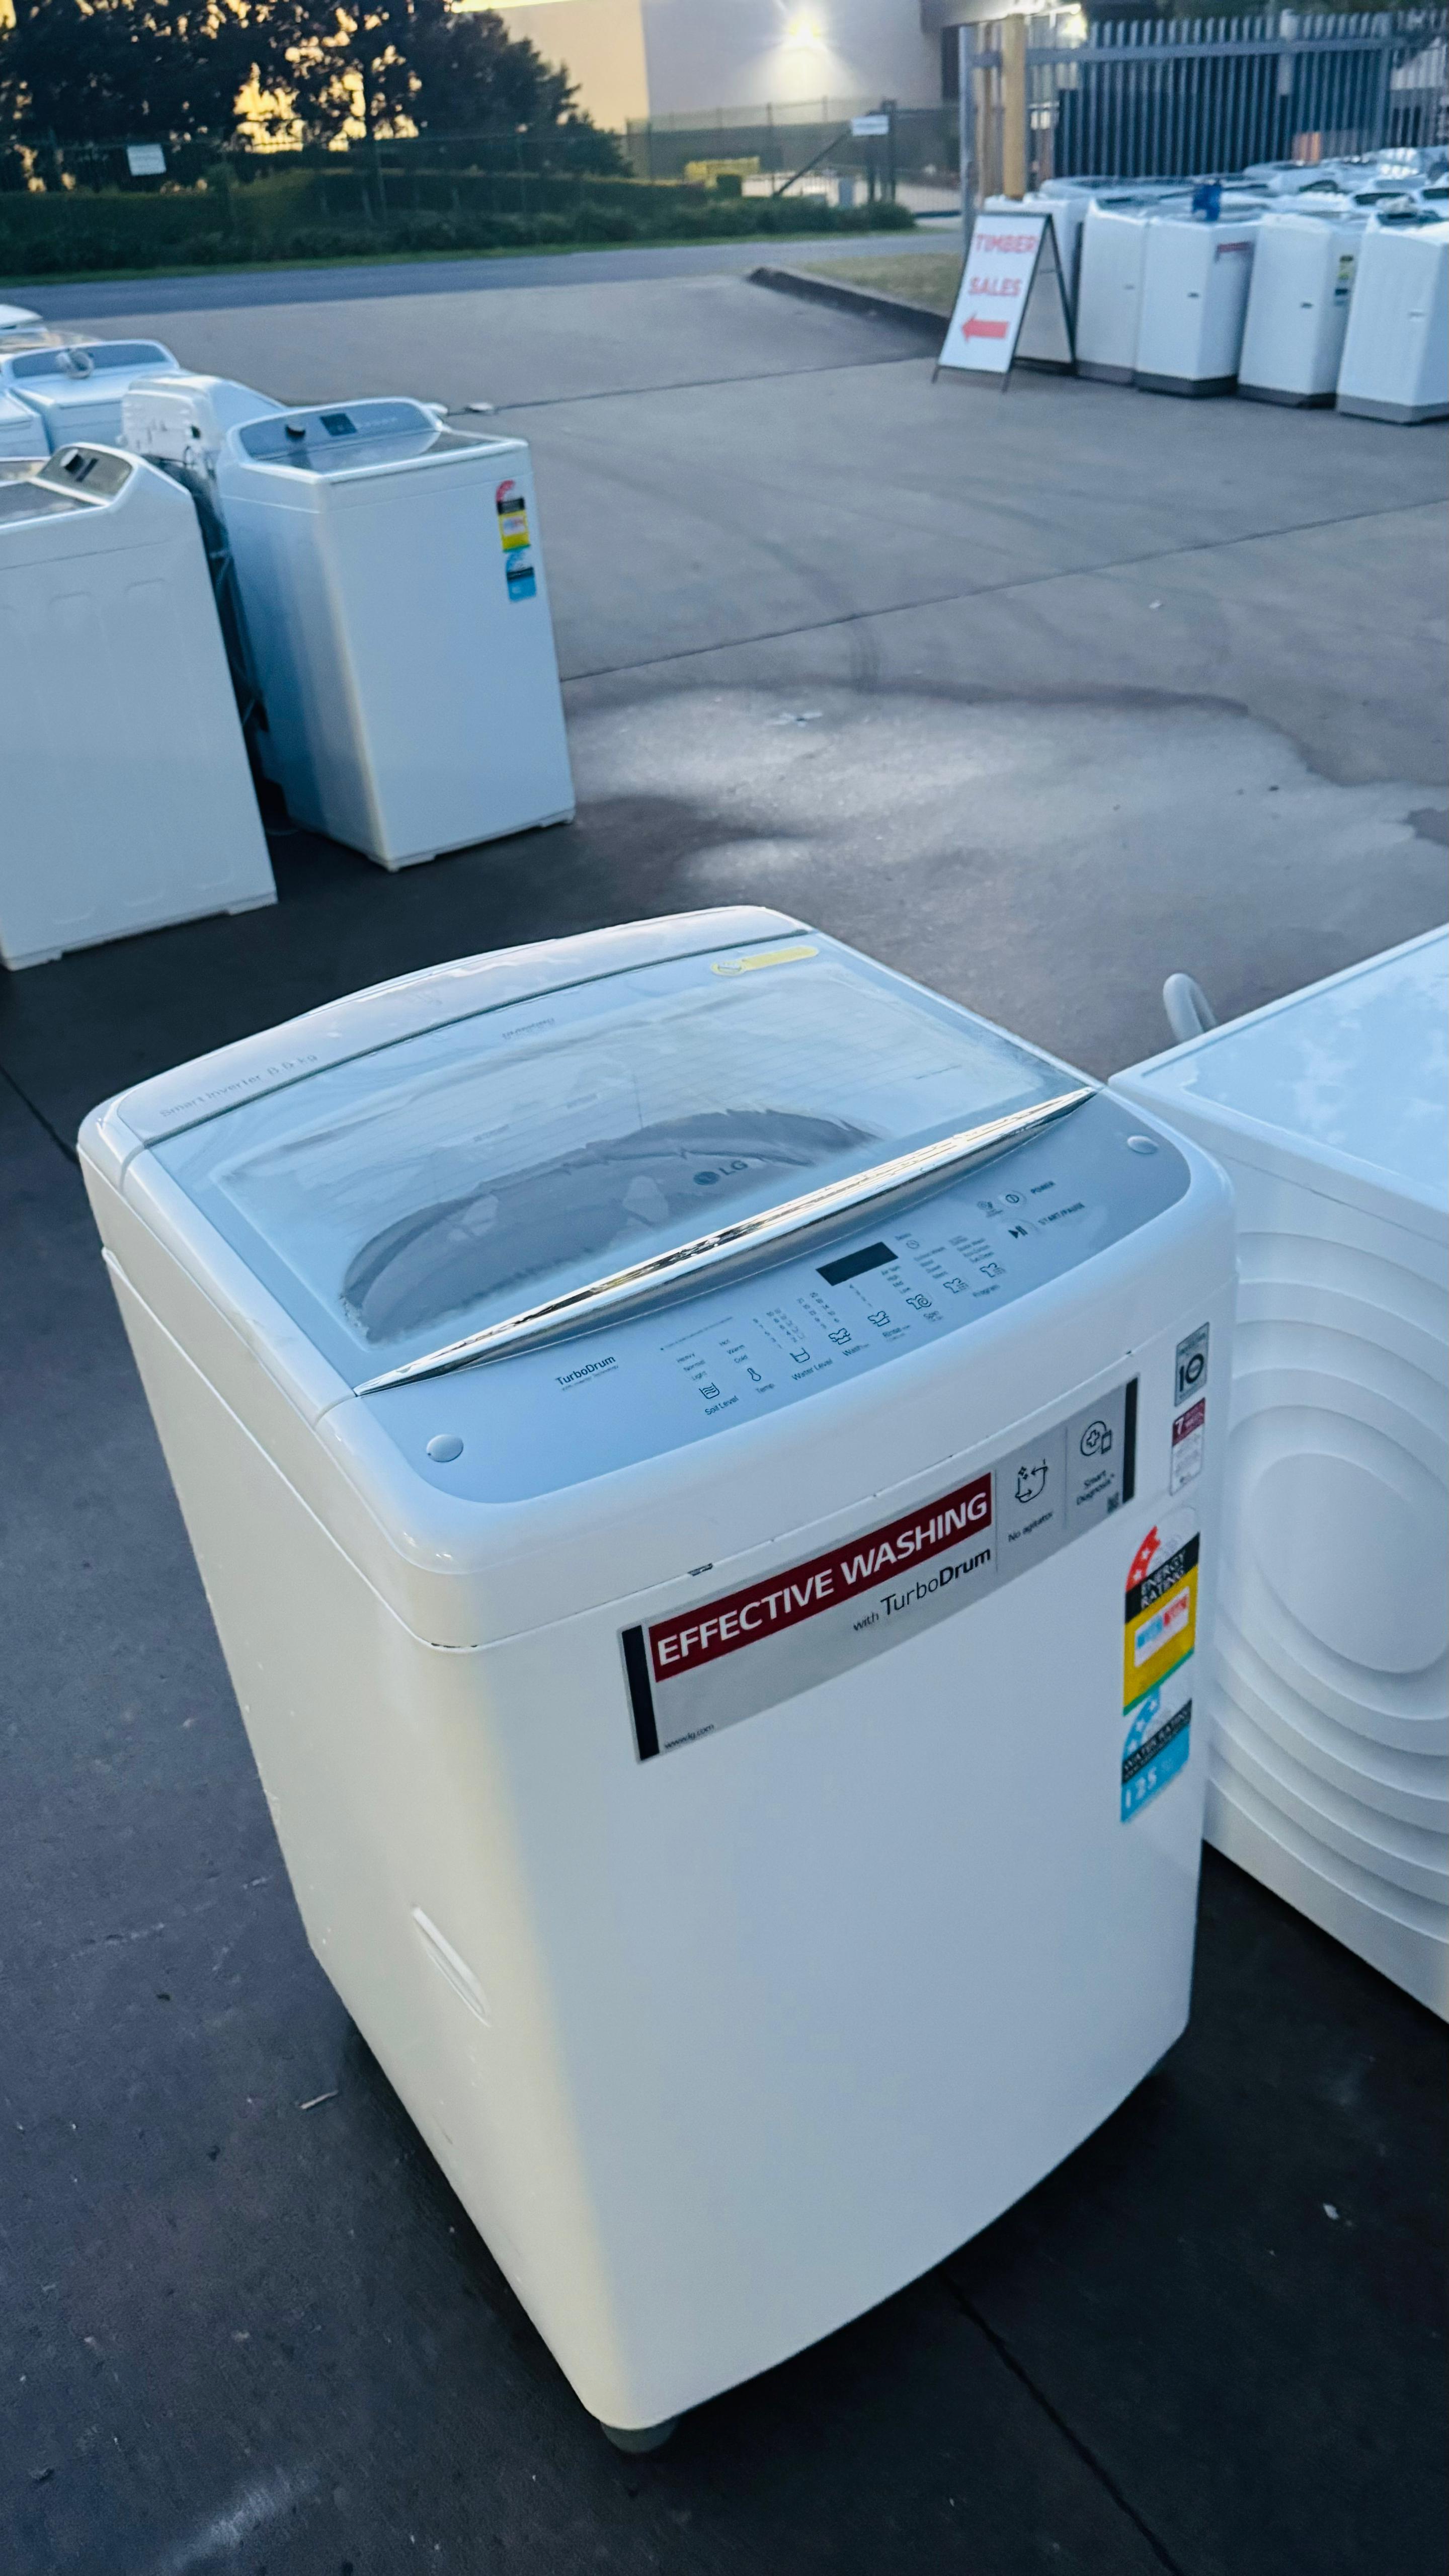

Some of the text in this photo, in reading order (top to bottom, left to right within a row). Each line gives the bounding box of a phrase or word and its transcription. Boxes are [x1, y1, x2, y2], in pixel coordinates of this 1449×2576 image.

[976, 234, 1037, 254] TIMBER
[969, 277, 1022, 296] SALES
[555, 1356, 616, 1385] TurboDrum
[1008, 1531, 1021, 1542] No
[657, 1491, 988, 1666] EFFECTIVE WASHING
[853, 1548, 991, 1631] with TurboDrum
